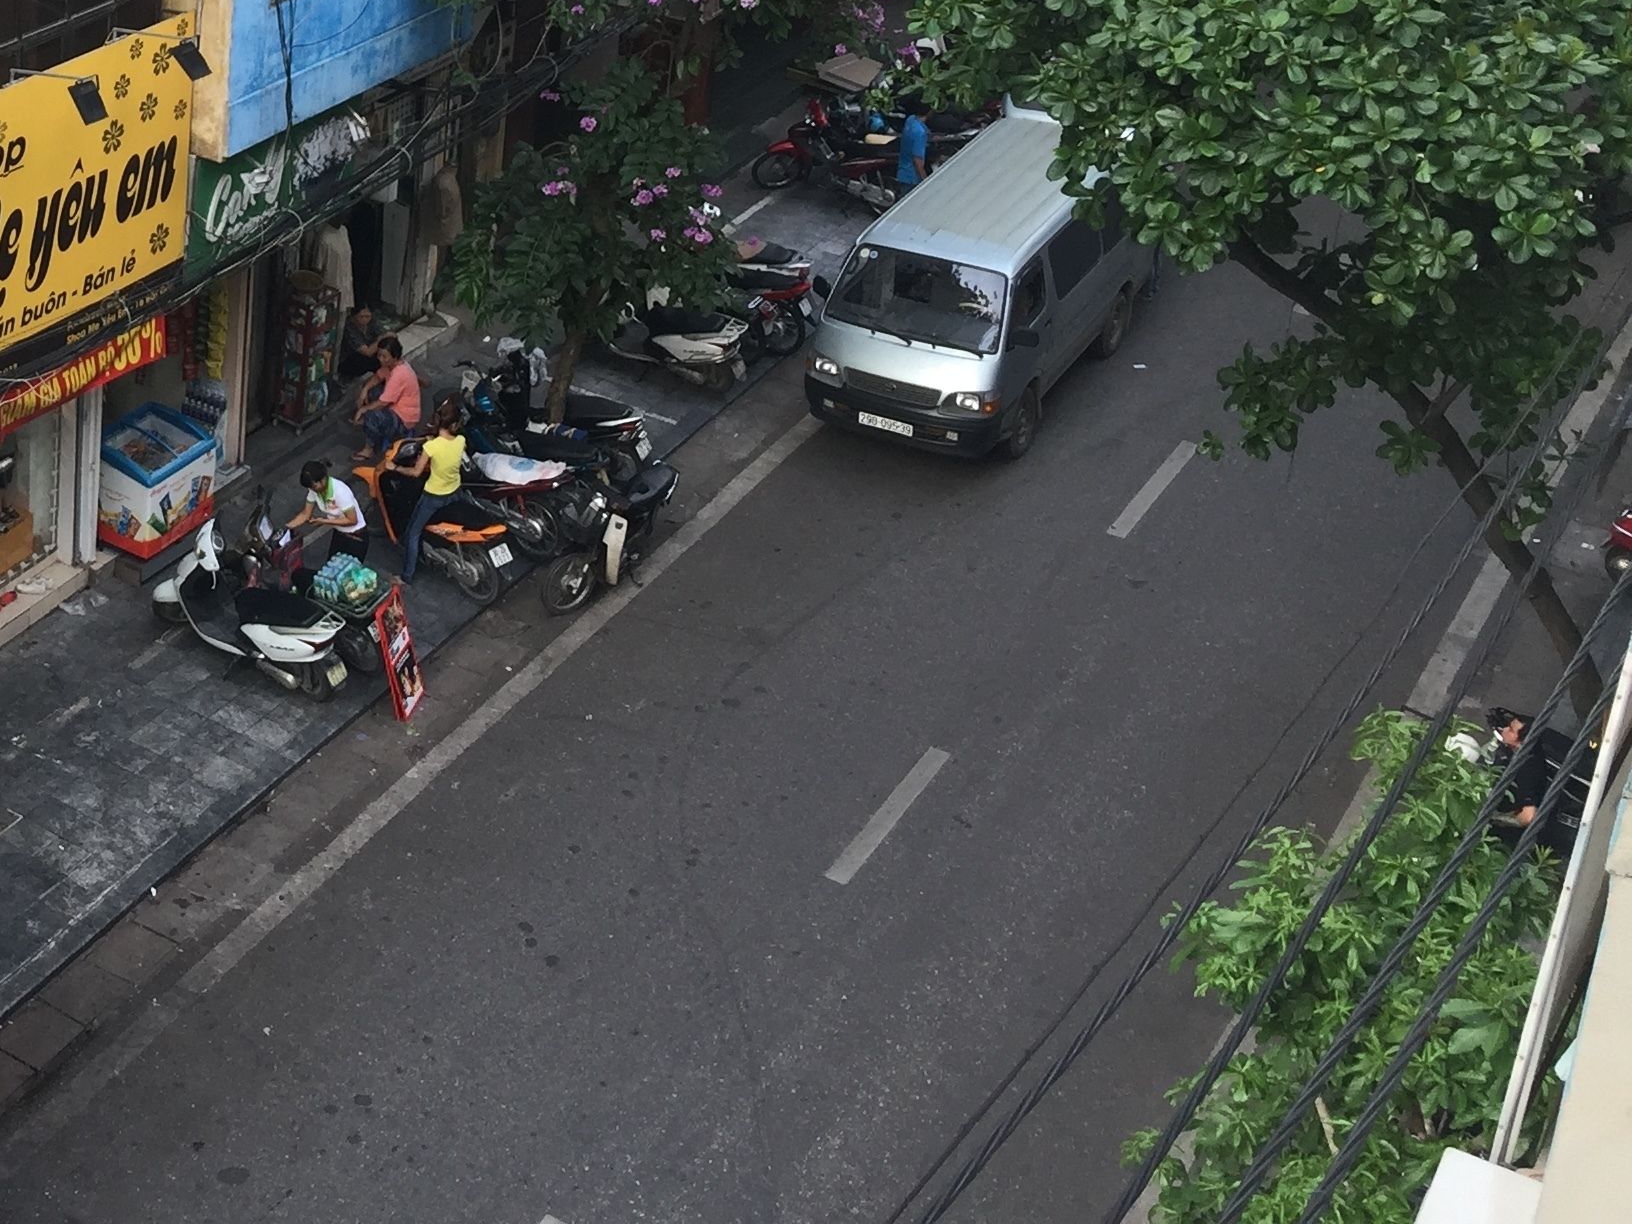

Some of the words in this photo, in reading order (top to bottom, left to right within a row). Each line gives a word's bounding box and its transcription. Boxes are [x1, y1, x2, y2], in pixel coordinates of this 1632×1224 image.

[24, 157, 109, 292] yêu
[116, 135, 177, 224] em
[21, 286, 67, 328] buôn
[82, 259, 116, 297] Bán
[120, 248, 137, 278] lẻ
[63, 356, 96, 396] TOÀN
